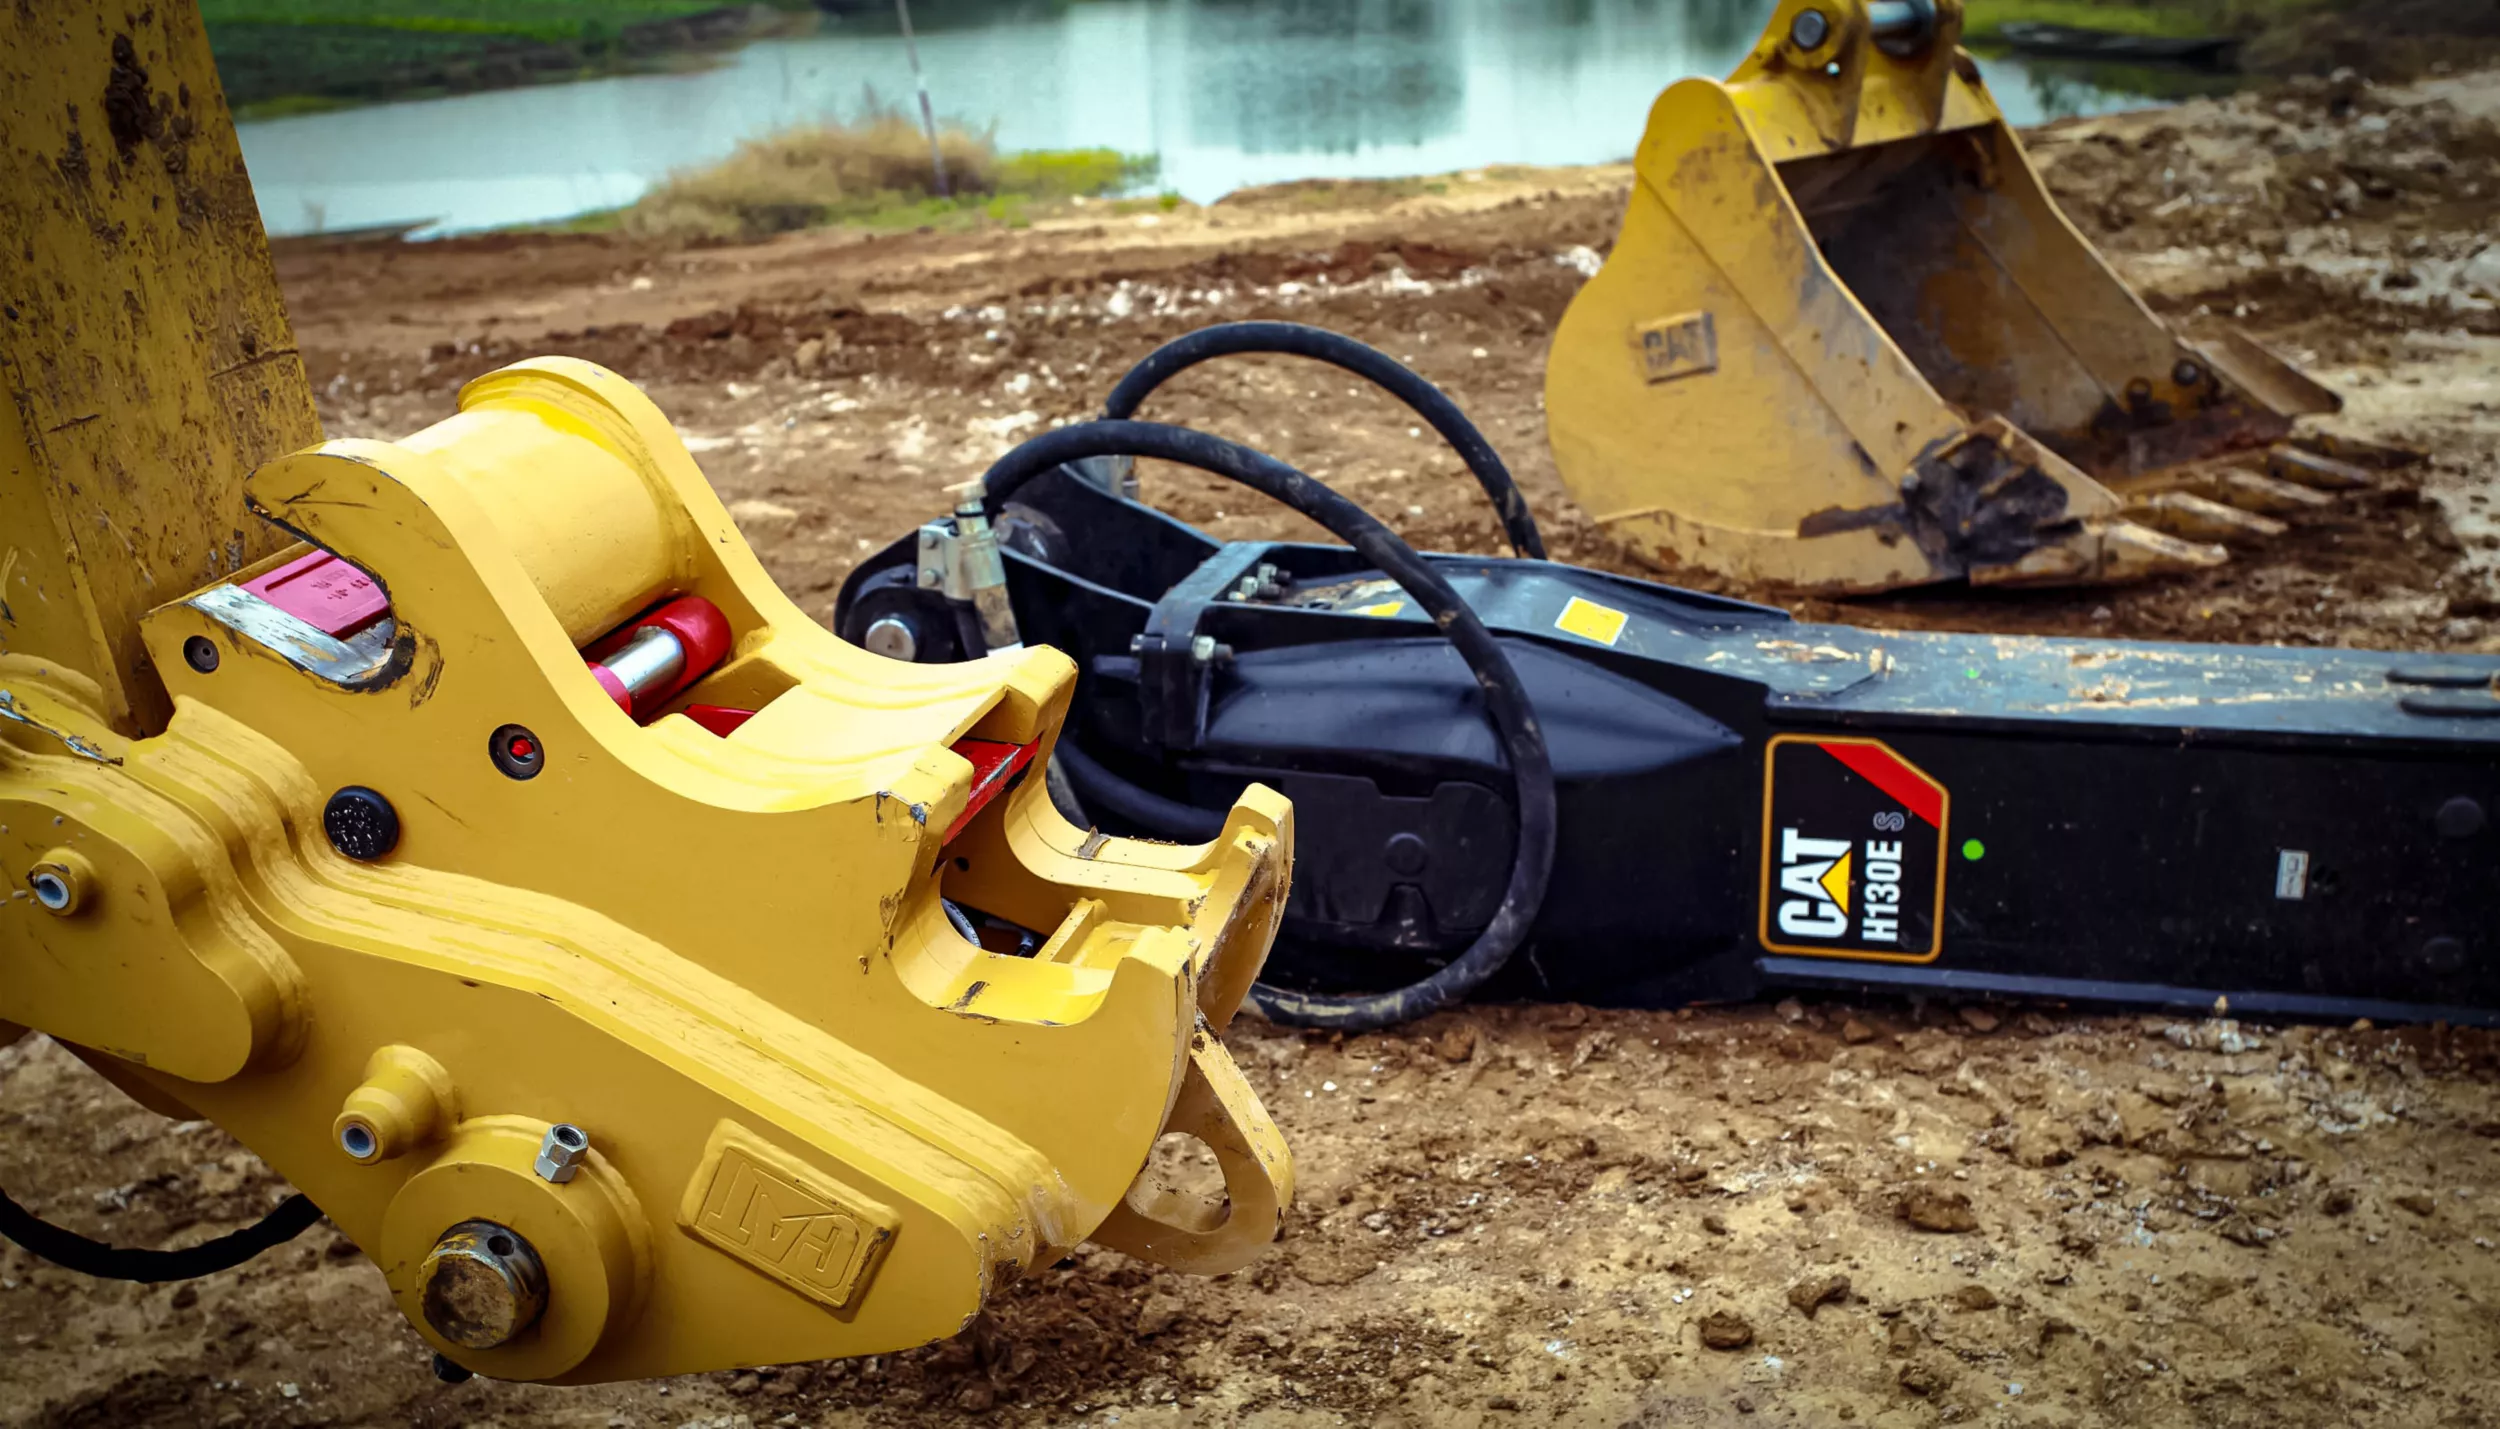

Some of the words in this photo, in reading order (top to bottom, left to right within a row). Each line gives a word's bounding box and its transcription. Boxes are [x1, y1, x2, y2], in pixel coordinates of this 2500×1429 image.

[1642, 320, 1705, 370] CAT
[1873, 811, 1905, 832] S
[1778, 827, 1852, 938] CAT
[1862, 839, 1903, 942] H130E
[704, 1162, 861, 1289] CAT
